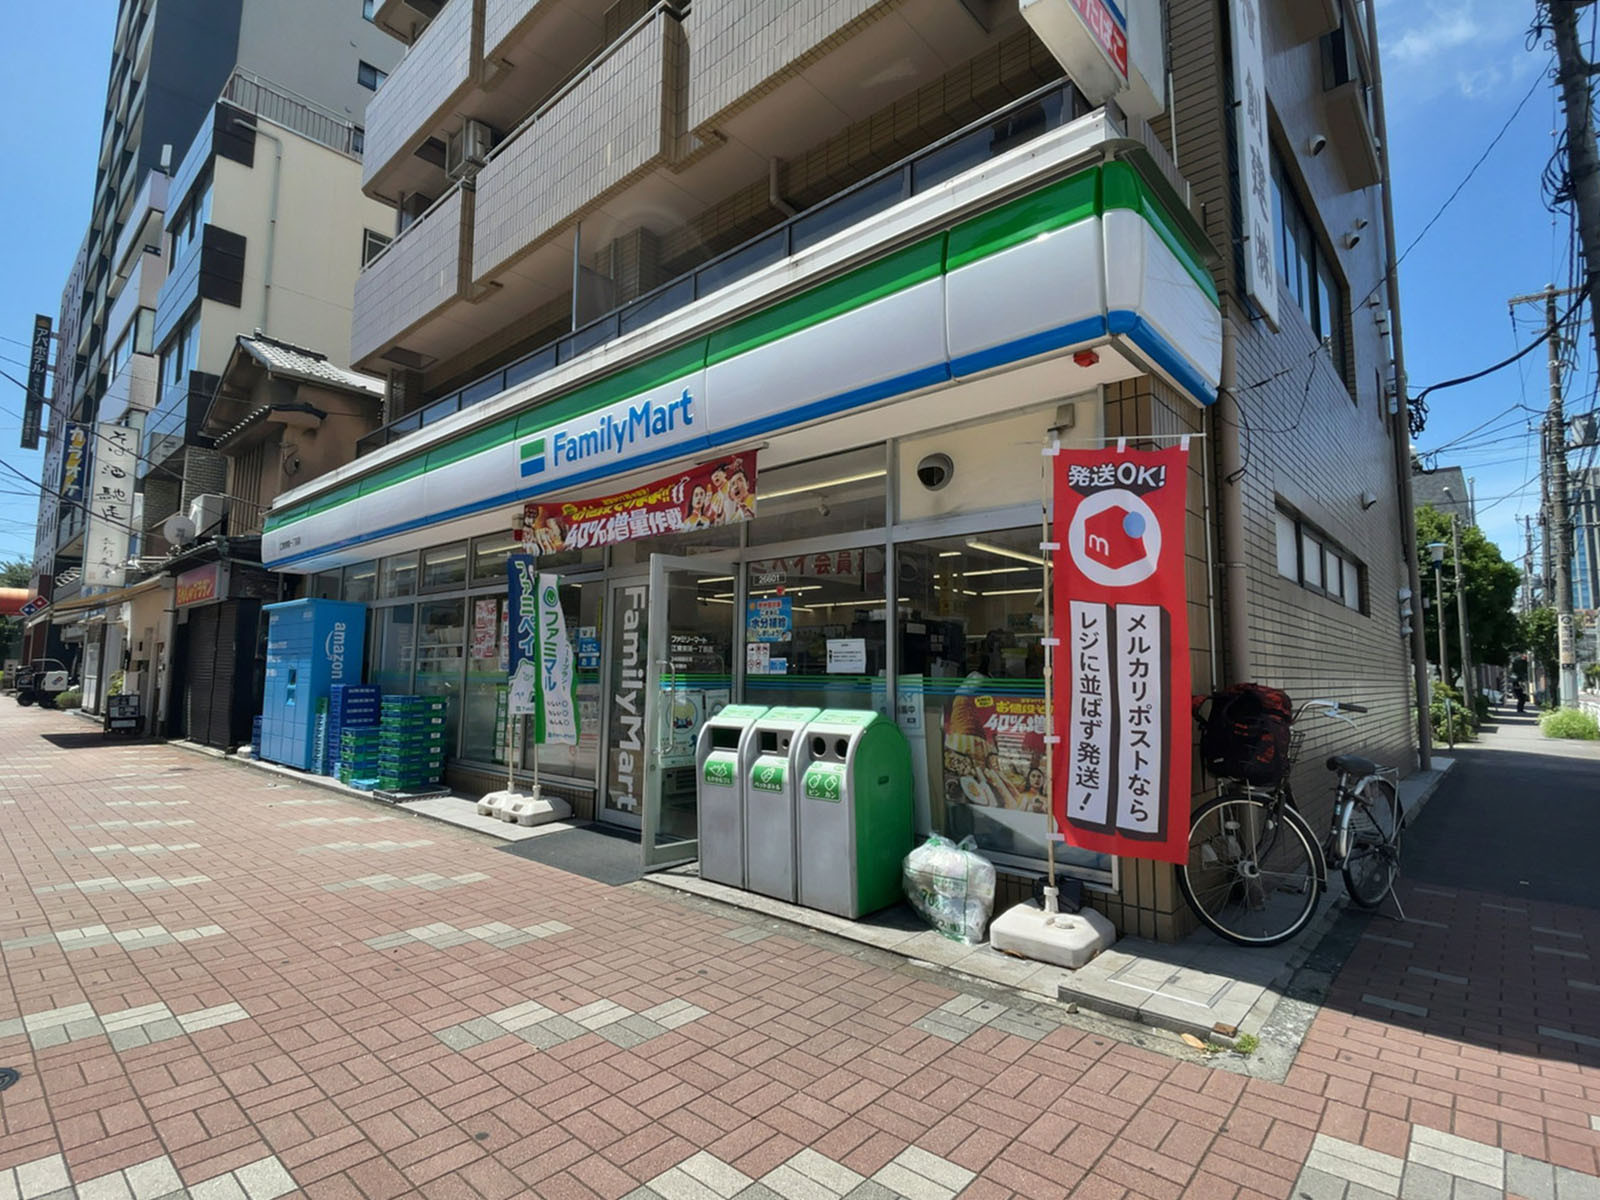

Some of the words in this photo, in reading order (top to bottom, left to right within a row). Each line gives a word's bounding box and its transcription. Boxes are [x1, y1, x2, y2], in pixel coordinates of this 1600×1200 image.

[553, 385, 694, 466] FamilyMart
[331, 622, 346, 679] amazon
[543, 611, 560, 692] ファミマル
[616, 586, 647, 812] FamilyMart
[1126, 613, 1152, 822] メルカリポストなら
